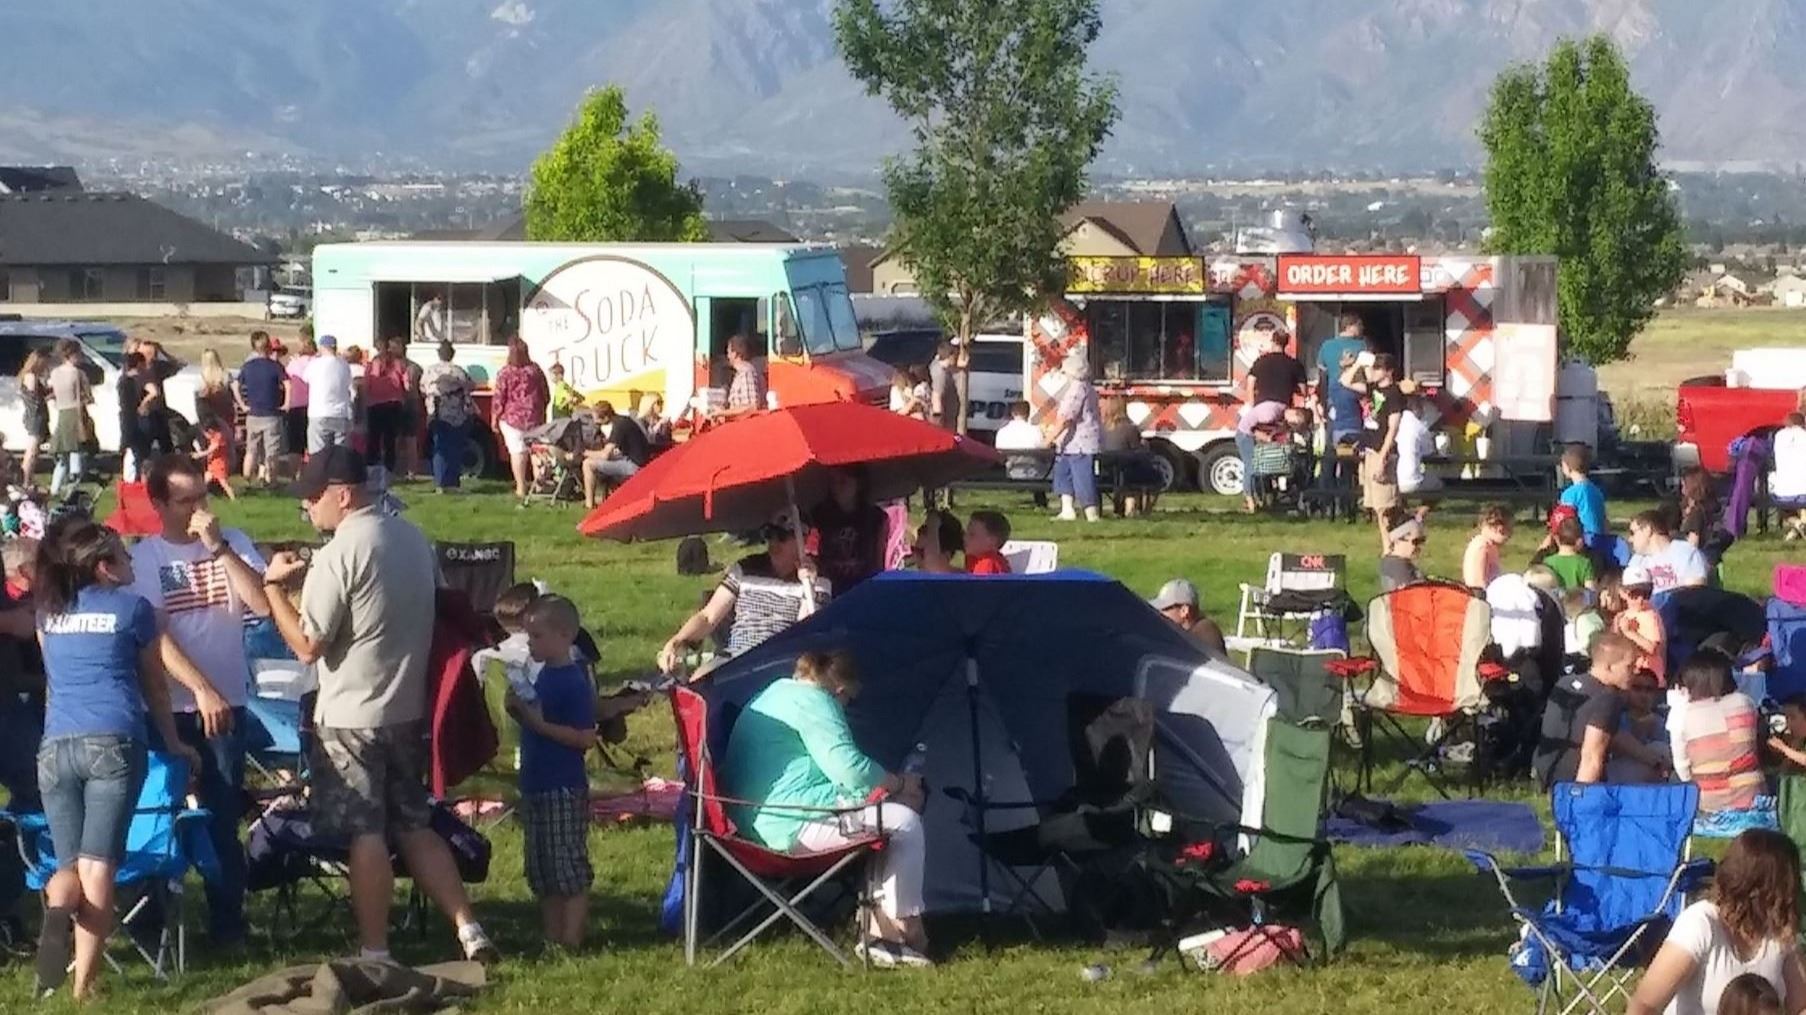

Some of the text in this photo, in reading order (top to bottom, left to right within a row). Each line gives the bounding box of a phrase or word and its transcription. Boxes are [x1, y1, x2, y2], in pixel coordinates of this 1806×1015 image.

[1150, 264, 1195, 285] HERE
[1287, 264, 1352, 286] ORDER
[1358, 264, 1411, 287] HERE
[574, 282, 656, 343] SODA
[548, 325, 658, 389] TRUCK
